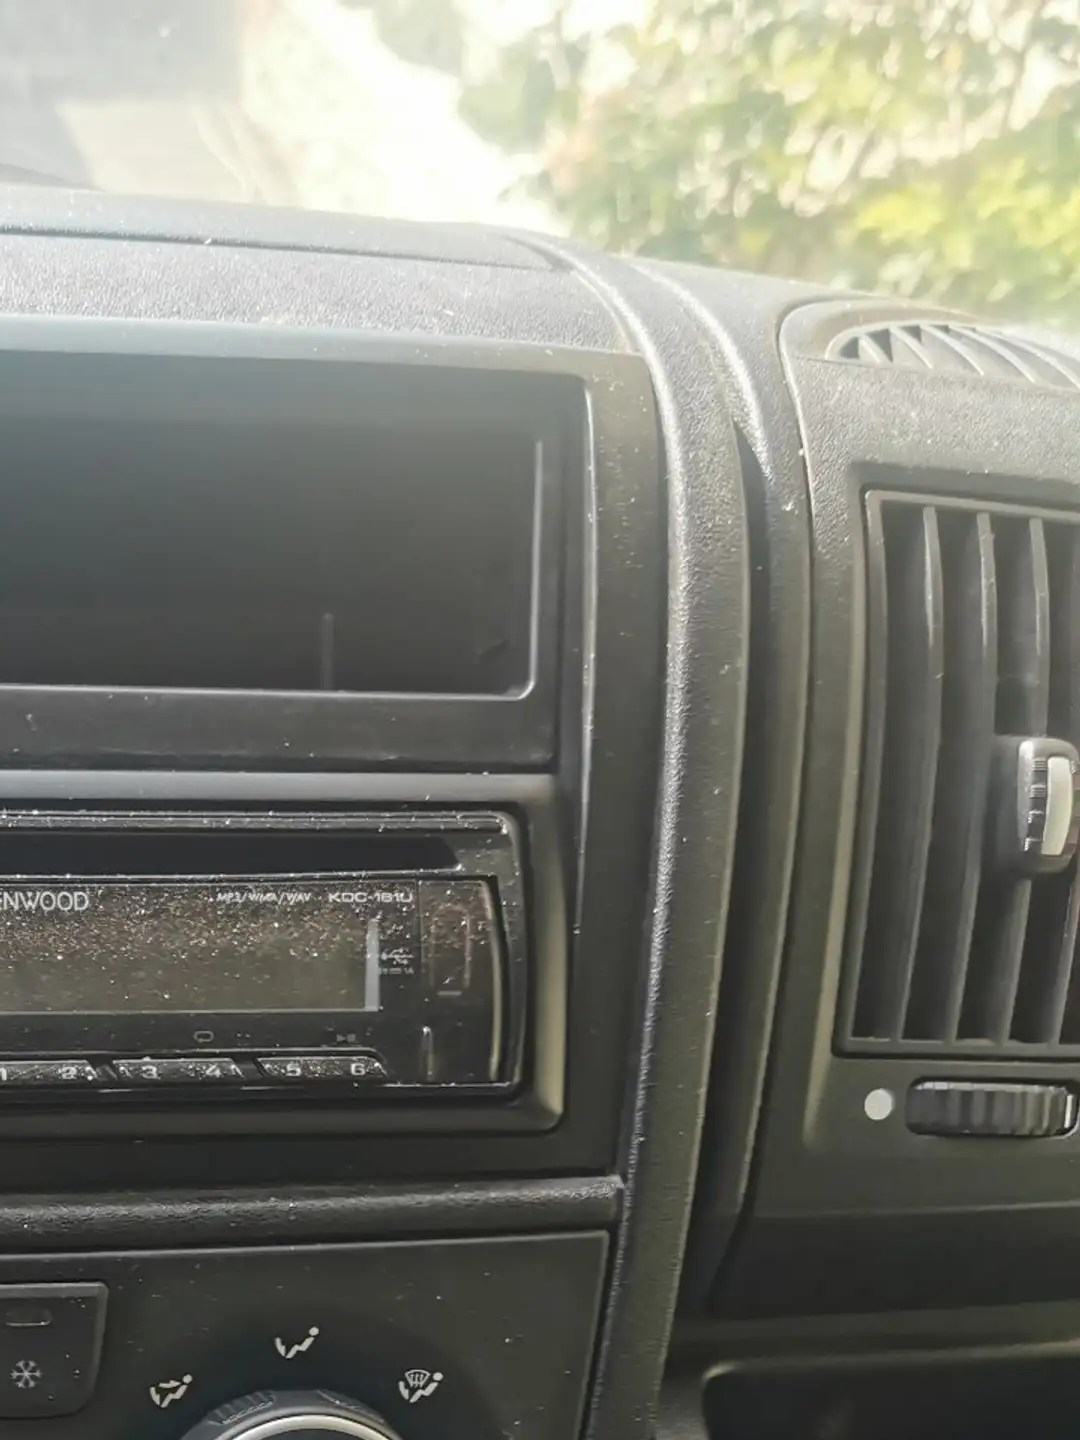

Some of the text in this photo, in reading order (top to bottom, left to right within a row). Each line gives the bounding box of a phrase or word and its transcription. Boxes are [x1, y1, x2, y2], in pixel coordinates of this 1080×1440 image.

[61, 1066, 77, 1080] 2
[141, 1065, 158, 1080] 3
[205, 1064, 221, 1078] 4
[286, 1063, 302, 1077] 5
[351, 1063, 366, 1076] 6
